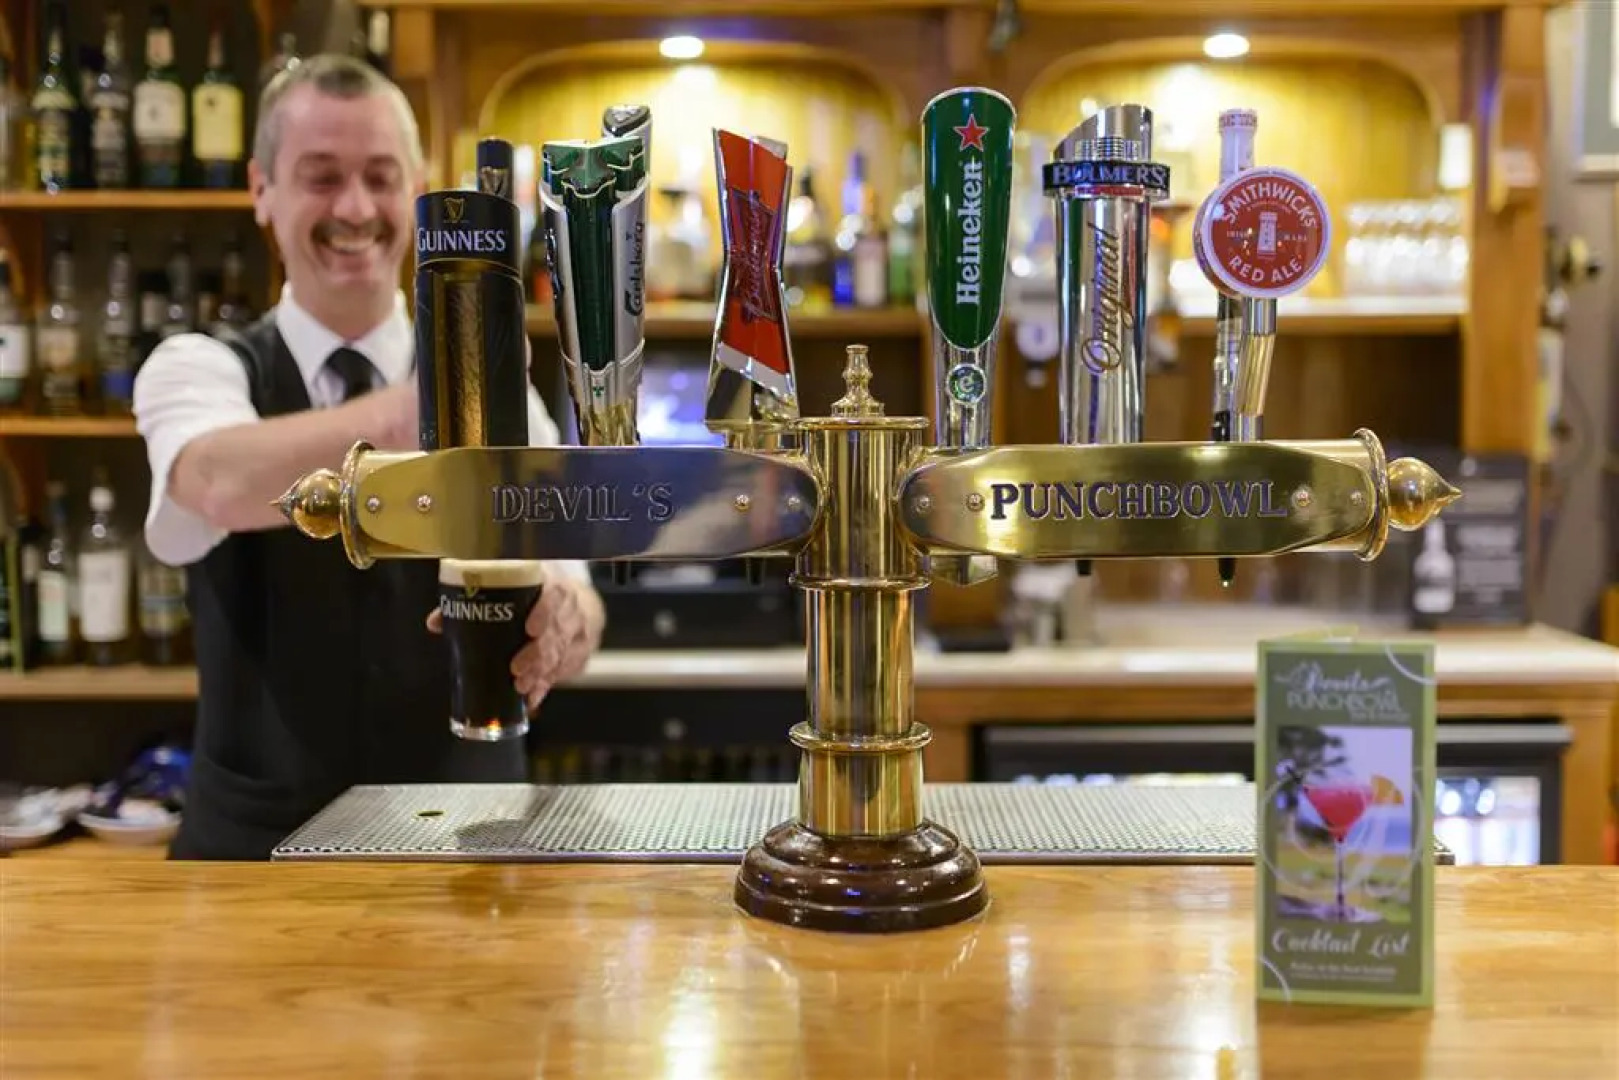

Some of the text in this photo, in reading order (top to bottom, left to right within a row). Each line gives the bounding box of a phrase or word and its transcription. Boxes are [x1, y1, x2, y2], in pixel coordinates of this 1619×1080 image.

[417, 228, 507, 252] GUINNESS
[956, 160, 983, 305] Heineken
[624, 222, 645, 317] Carlsberg
[1229, 255, 1302, 282] RED ALE
[1082, 222, 1134, 374] Original
[492, 483, 675, 522] DEVIL'S
[990, 480, 1289, 520] PUNCHBOWL
[440, 594, 514, 622] GUINNESS
[1272, 929, 1361, 953] Cocktail
